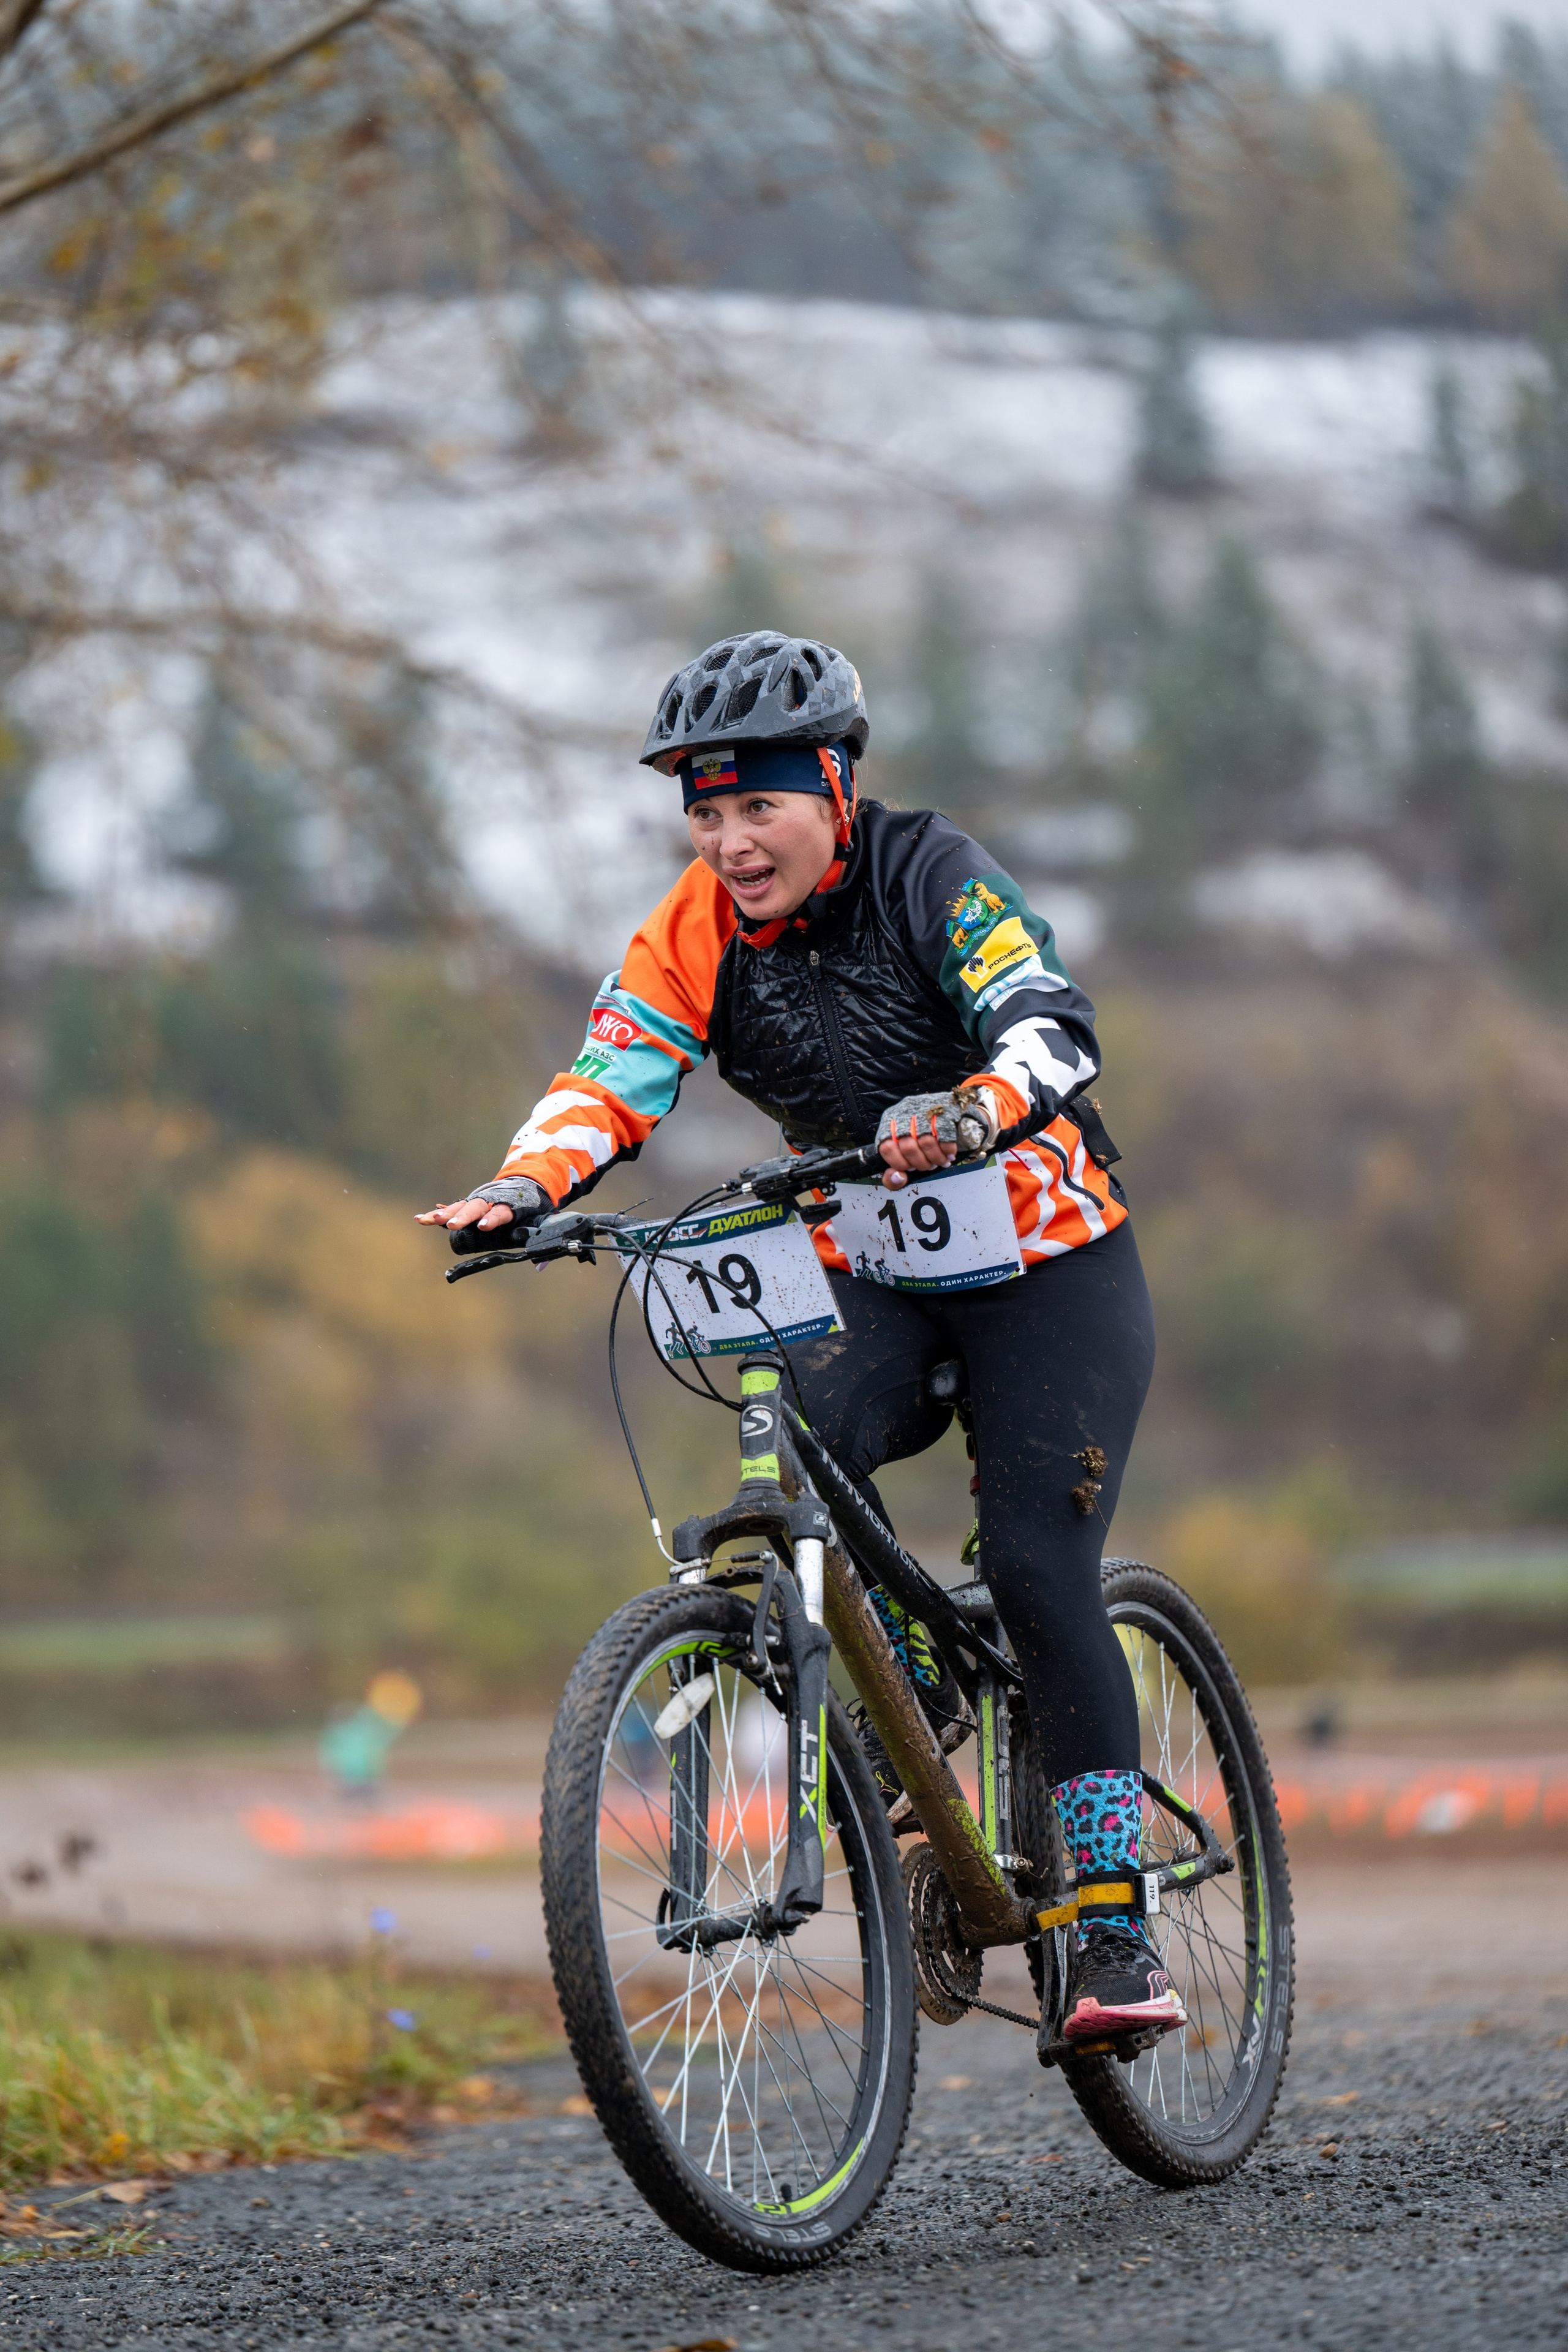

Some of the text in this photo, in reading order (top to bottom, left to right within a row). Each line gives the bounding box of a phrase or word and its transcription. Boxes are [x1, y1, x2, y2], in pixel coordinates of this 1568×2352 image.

[988, 943, 1031, 970] РОСНЕФТЬ
[600, 1051, 615, 1061] АЗС
[644, 1224, 704, 1243] КОСС
[708, 1204, 783, 1237] ДУАТЛОН
[877, 1196, 951, 1252] 19
[686, 1254, 761, 1313] 19
[963, 1270, 1006, 1283] ХАРАКТЕР.
[733, 1340, 758, 1349] ЭТАПА.
[782, 1324, 824, 1338] ХАРАКТЕР.
[822, 1447, 917, 1578] NAVIGATOR
[799, 1719, 818, 1823] XCT
[1269, 1924, 1290, 2056] STELS
[751, 2221, 832, 2243] STELS
